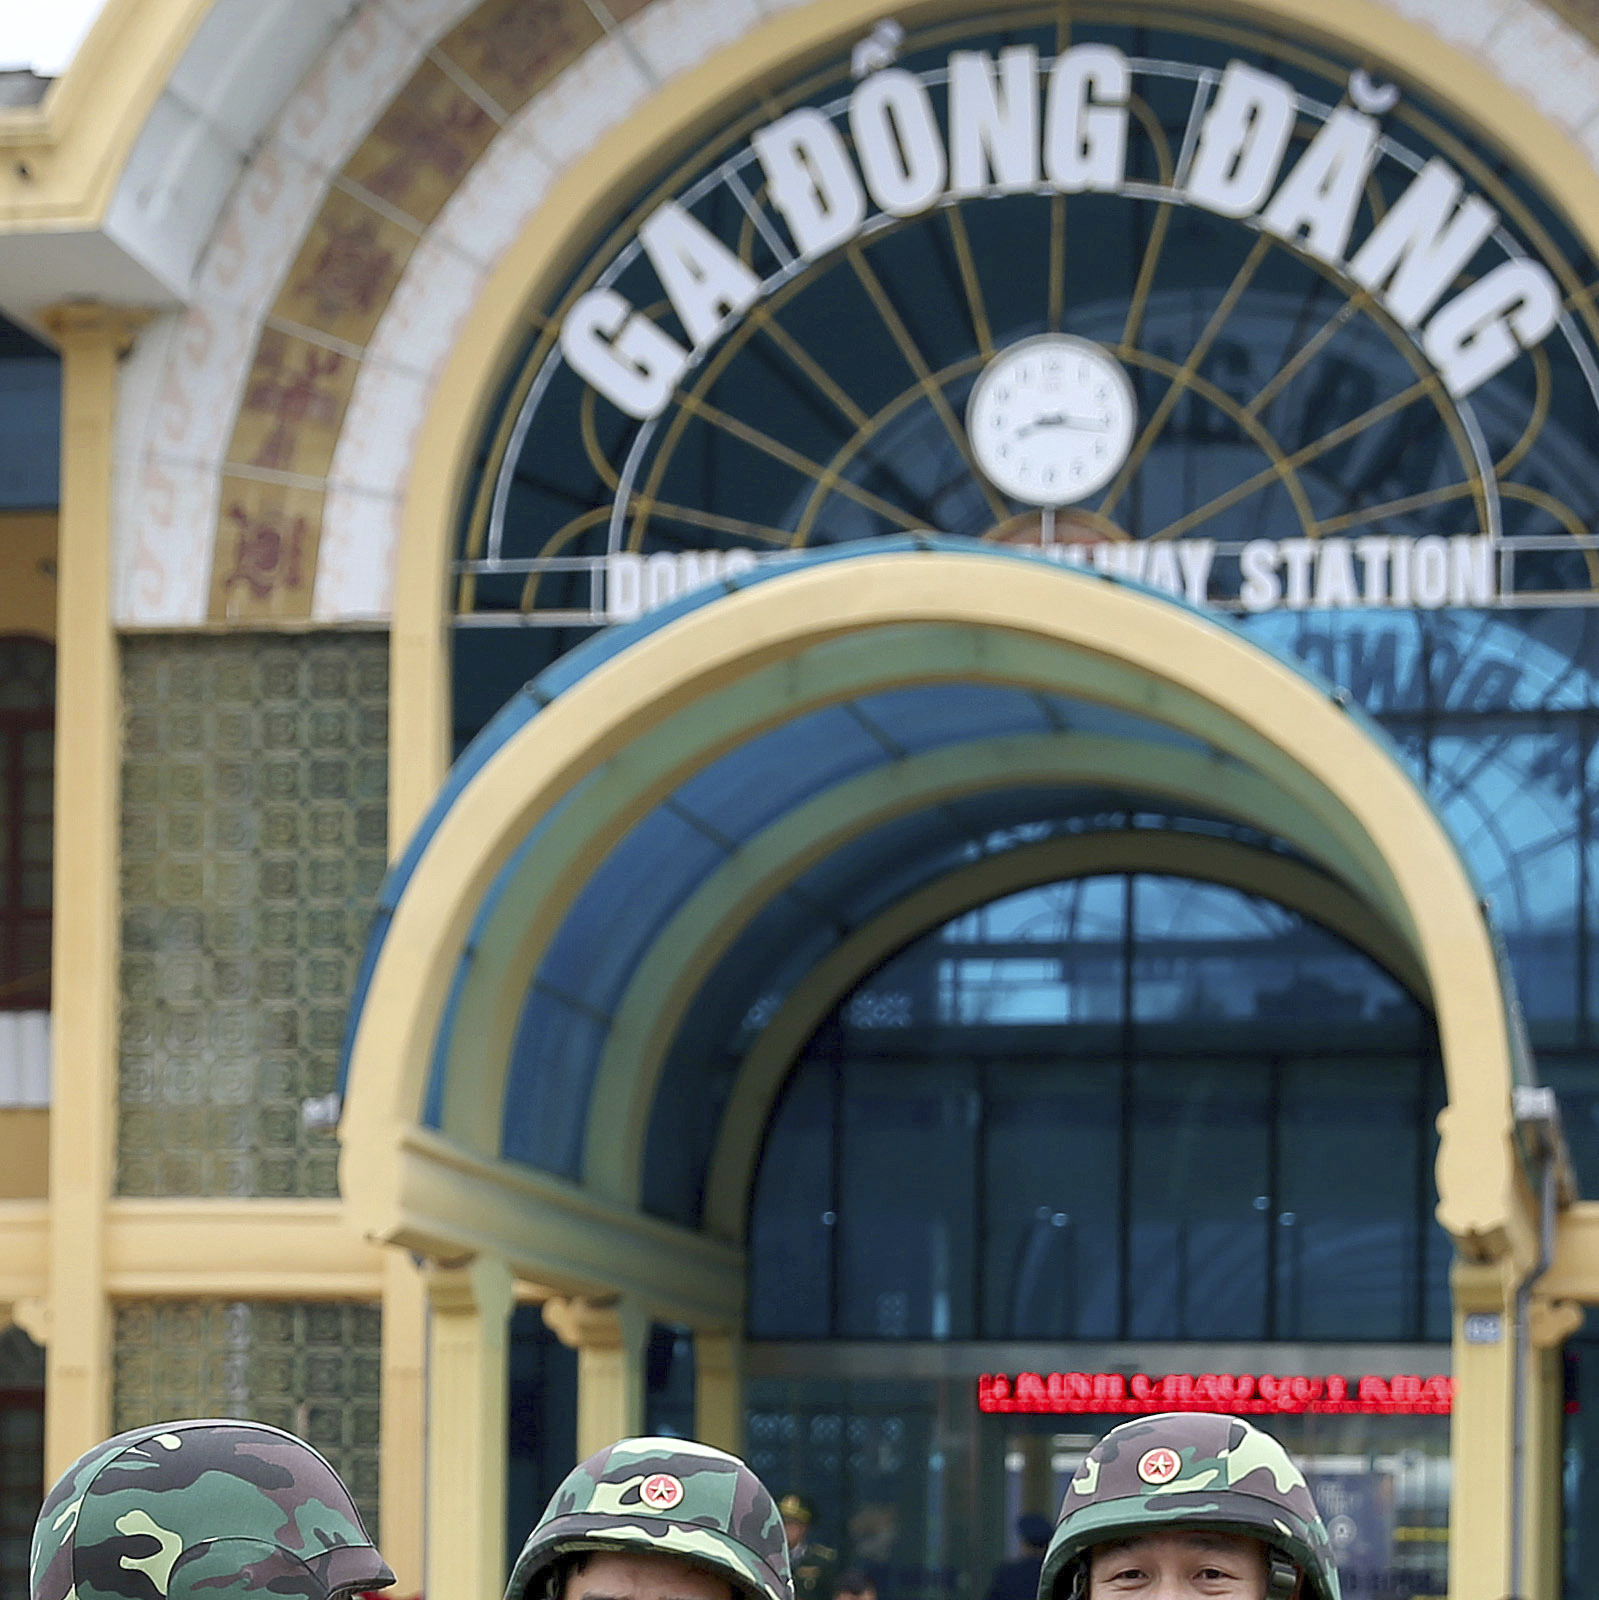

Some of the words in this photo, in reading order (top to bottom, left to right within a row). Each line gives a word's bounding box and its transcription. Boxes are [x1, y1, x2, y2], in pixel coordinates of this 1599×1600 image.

[560, 200, 766, 420] GA
[1186, 57, 1562, 401] ĐĂNG
[1239, 534, 1497, 613] STATION
